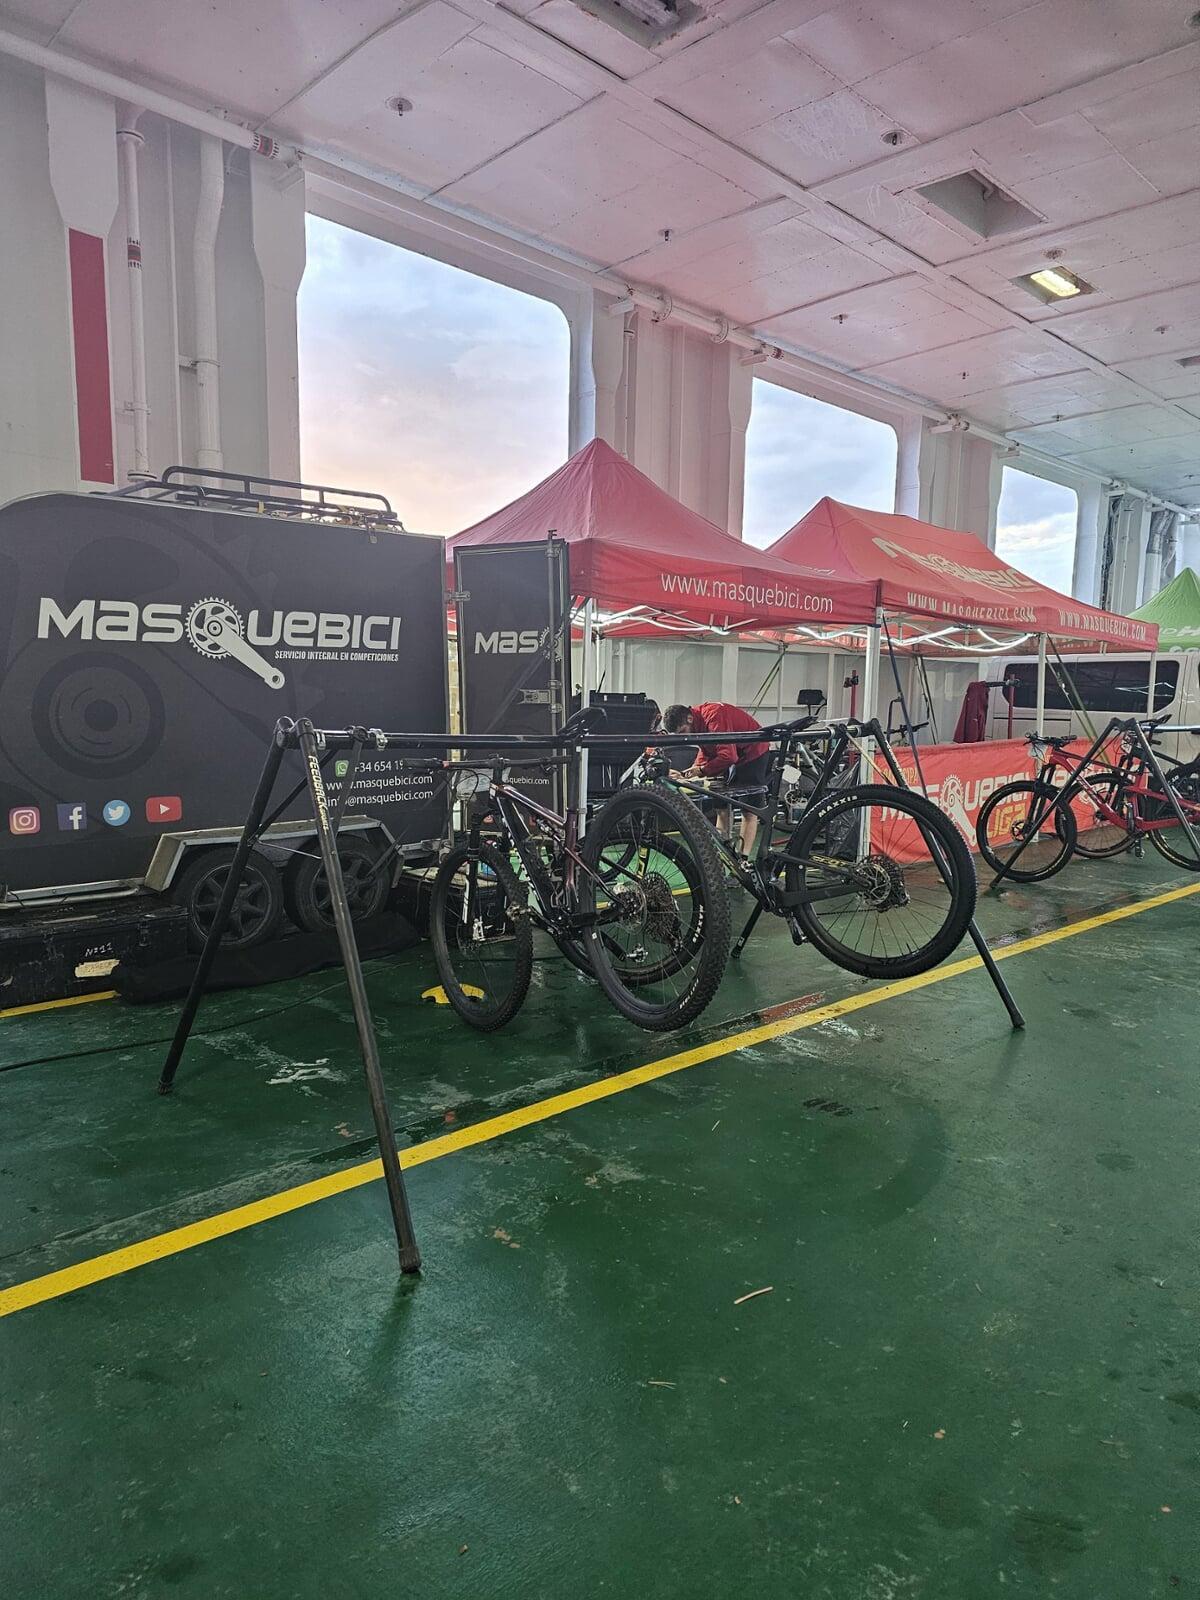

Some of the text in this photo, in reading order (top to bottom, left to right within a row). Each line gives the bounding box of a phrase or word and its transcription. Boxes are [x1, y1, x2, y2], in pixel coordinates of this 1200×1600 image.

[661, 573, 834, 614] www.masquebici.com
[1058, 608, 1146, 641] WWW.MASQUEBICI.COM
[275, 650, 399, 662] SERVICIO INTEGRAL EN COMPETICIONES
[374, 761, 392, 772] 654
[326, 775, 433, 791] ww.masquebici.com
